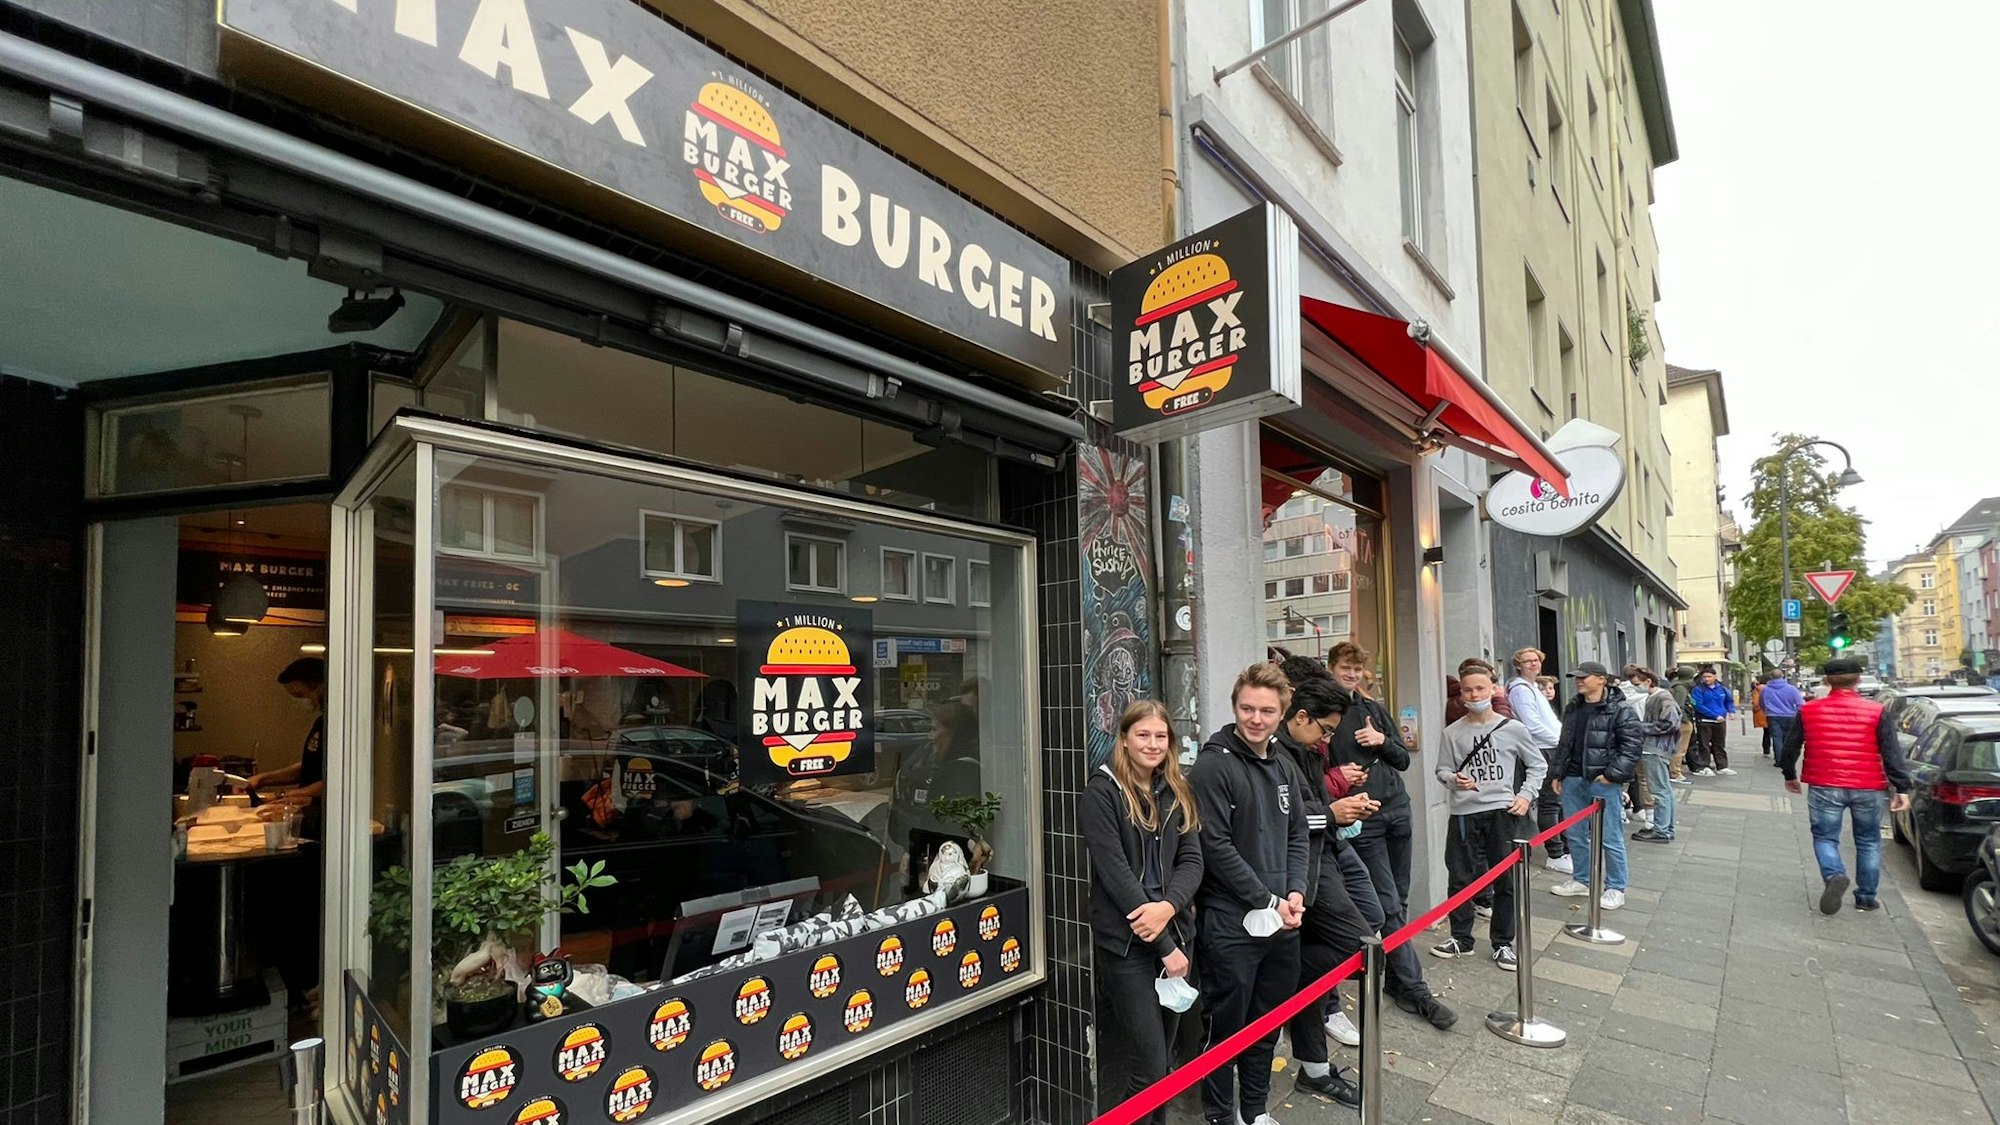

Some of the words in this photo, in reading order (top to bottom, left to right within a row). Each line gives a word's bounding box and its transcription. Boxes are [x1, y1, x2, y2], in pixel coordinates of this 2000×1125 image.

[728, 74, 764, 103] MILLION
[684, 110, 791, 189] MAX
[333, 0, 655, 148] AX
[821, 164, 1058, 342] BURGER
[684, 141, 792, 211] BURGER
[730, 208, 754, 227] FREE
[1157, 262, 1162, 271] 1
[1166, 239, 1211, 265] MILLION
[1129, 291, 1244, 362] MAX
[1129, 327, 1247, 385] BURGER
[1173, 392, 1199, 410] FREE
[1501, 500, 1545, 517] cosita
[1551, 492, 1600, 510] bonita
[220, 562, 255, 573] MAX
[260, 565, 314, 577] BURGER
[1787, 602, 1797, 617] P
[785, 617, 790, 627] 1
[794, 615, 836, 630] MILLION
[753, 677, 862, 711] MAX
[752, 709, 863, 735] BURGER
[800, 758, 825, 771] FREE
[1470, 766, 1504, 783] SPEED
[623, 772, 656, 783] MAX
[736, 990, 770, 1011] MAX
[206, 1018, 252, 1037] YOUR
[650, 1012, 690, 1036] MAX
[779, 1025, 812, 1047] MAX
[205, 1033, 252, 1054] MIND
[558, 1039, 604, 1065] MAX
[697, 1052, 734, 1076] MAX
[462, 1063, 516, 1090] MAX
[609, 1080, 652, 1106] MAX
